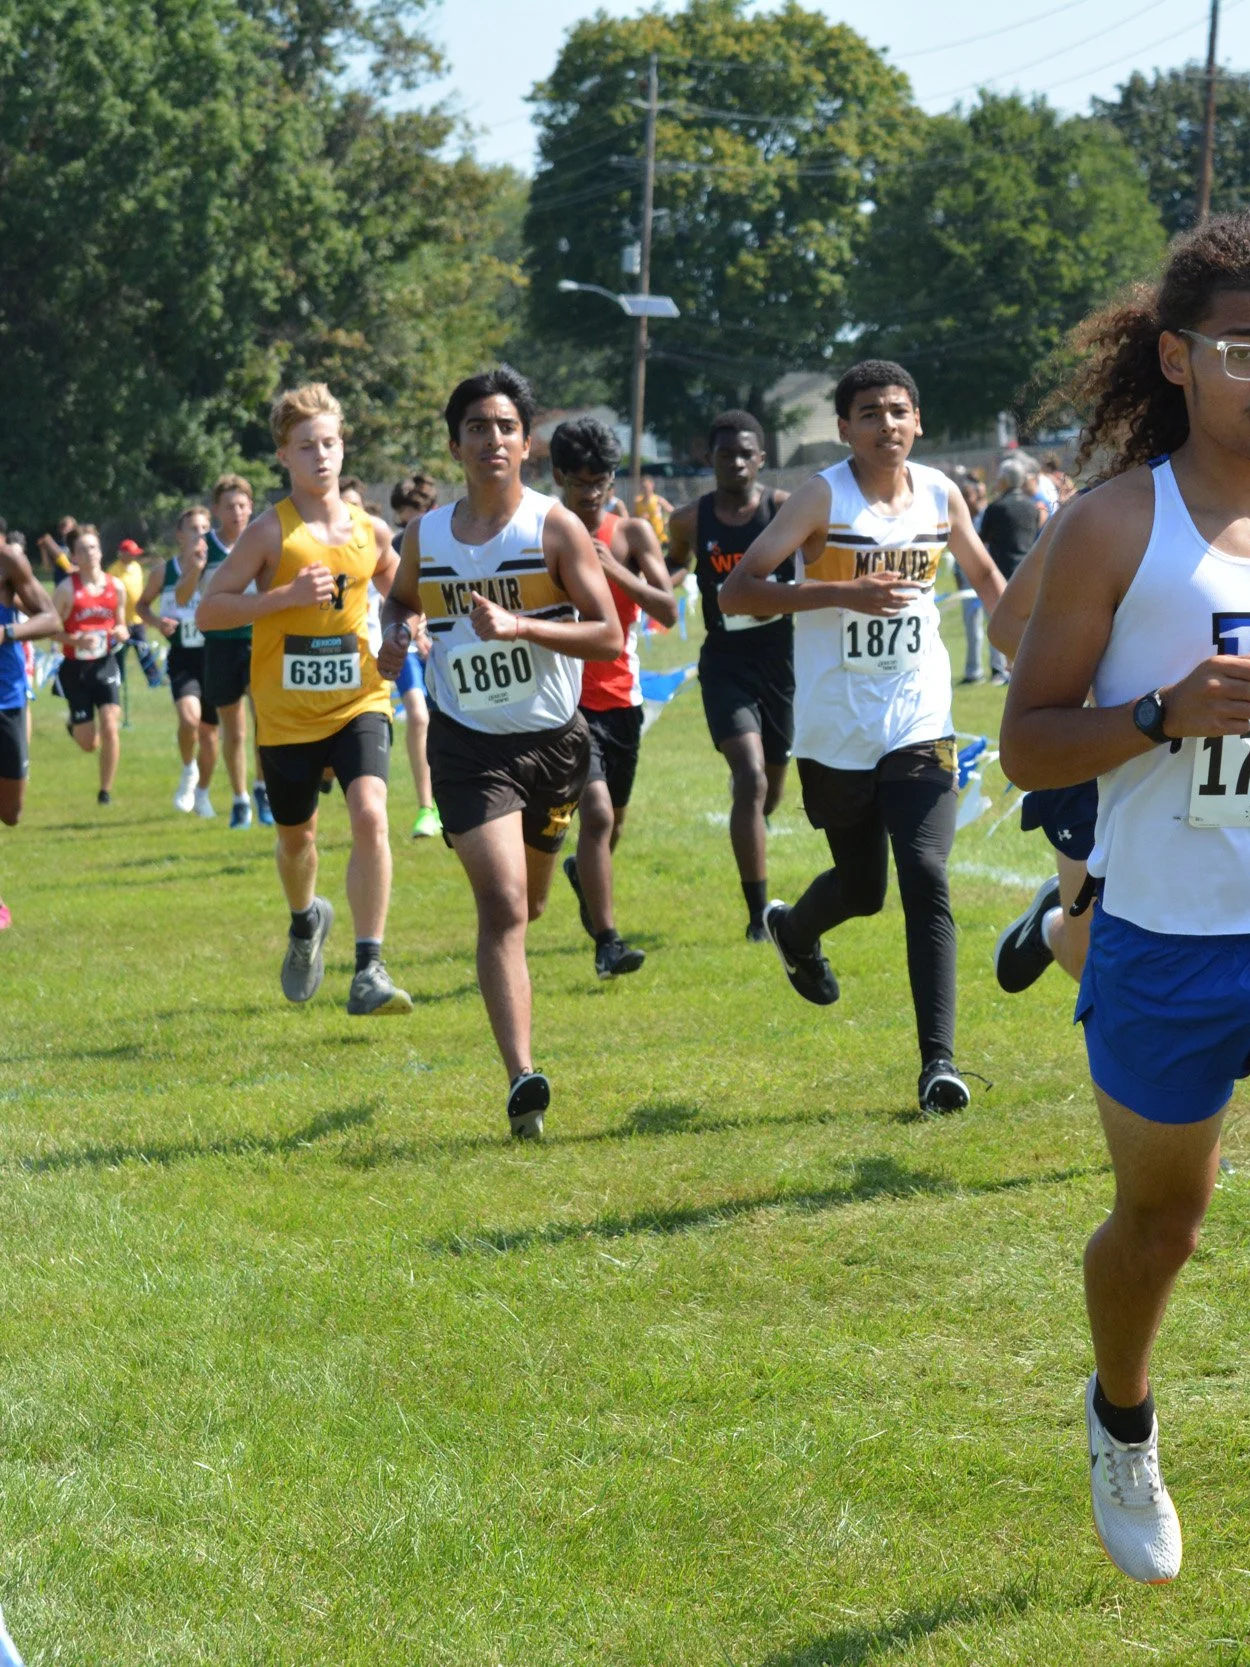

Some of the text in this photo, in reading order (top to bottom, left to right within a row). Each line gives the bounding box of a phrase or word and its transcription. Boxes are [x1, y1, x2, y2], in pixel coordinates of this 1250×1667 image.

[854, 549, 929, 581] MCNAIR
[441, 577, 523, 615] MCNAIR
[847, 616, 922, 659] 1873
[290, 659, 354, 686] 6335
[453, 646, 532, 694] 1860
